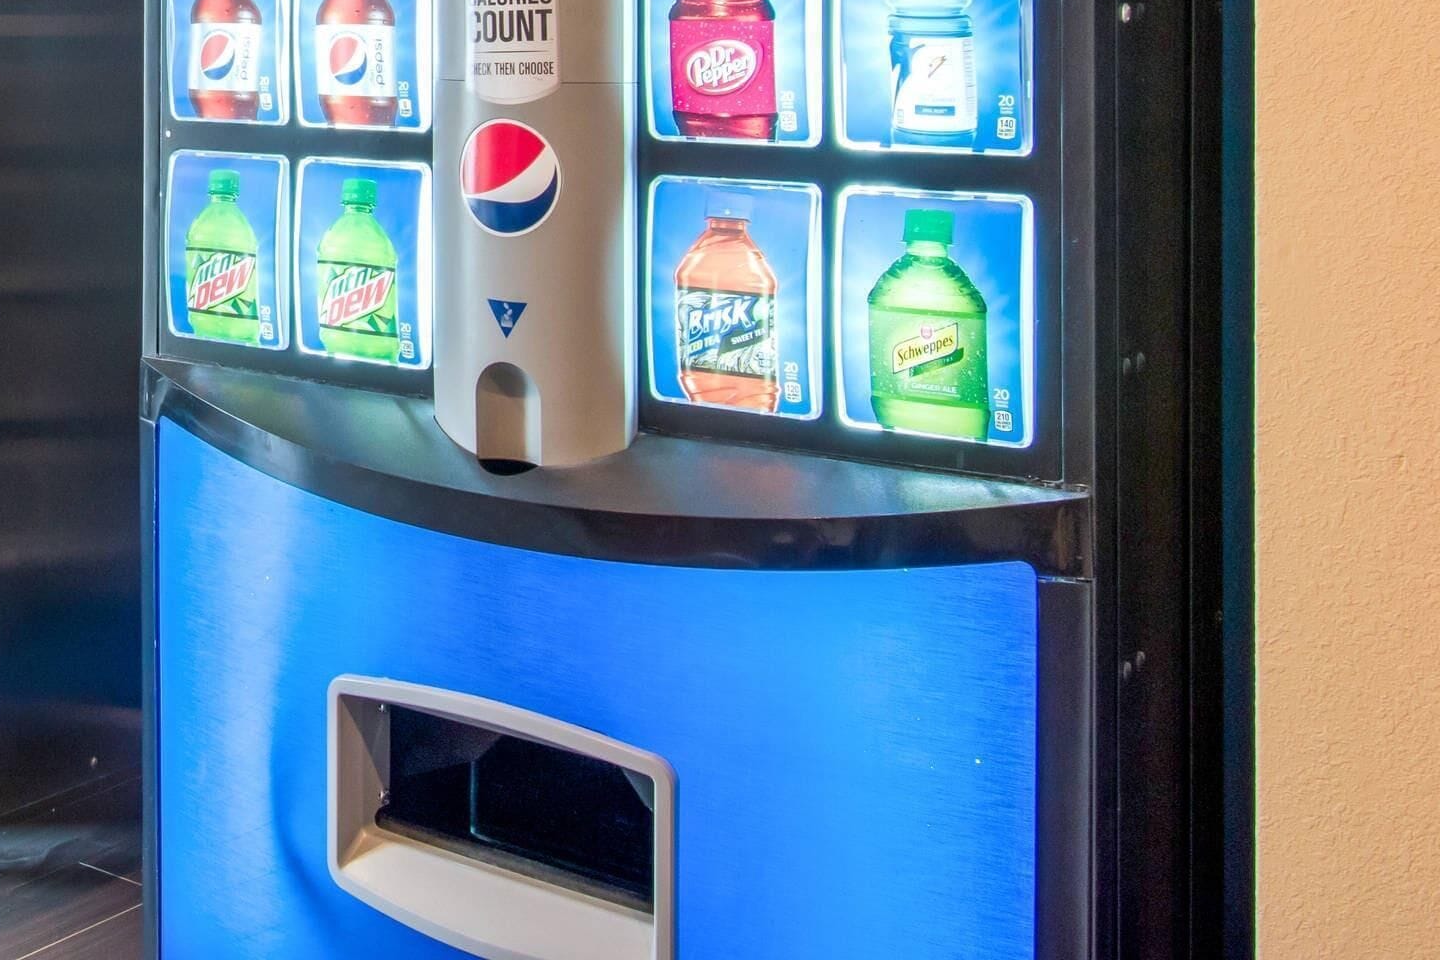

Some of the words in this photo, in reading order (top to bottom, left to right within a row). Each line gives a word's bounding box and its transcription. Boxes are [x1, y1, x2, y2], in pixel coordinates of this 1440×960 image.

[375, 38, 385, 85] pepsi
[709, 46, 735, 66] Dr
[473, 62, 492, 75] HECK
[494, 62, 515, 75] THEN
[519, 61, 554, 75] CHOOSE
[691, 50, 752, 87] Pepper
[998, 95, 1015, 107] 20
[1000, 119, 1014, 129] 140
[731, 332, 753, 344] SWEET
[897, 335, 953, 366] Schweppes
[784, 362, 798, 372] 20
[942, 385, 957, 394] ALE
[993, 388, 1010, 400] 20
[997, 412, 1010, 421] 210
